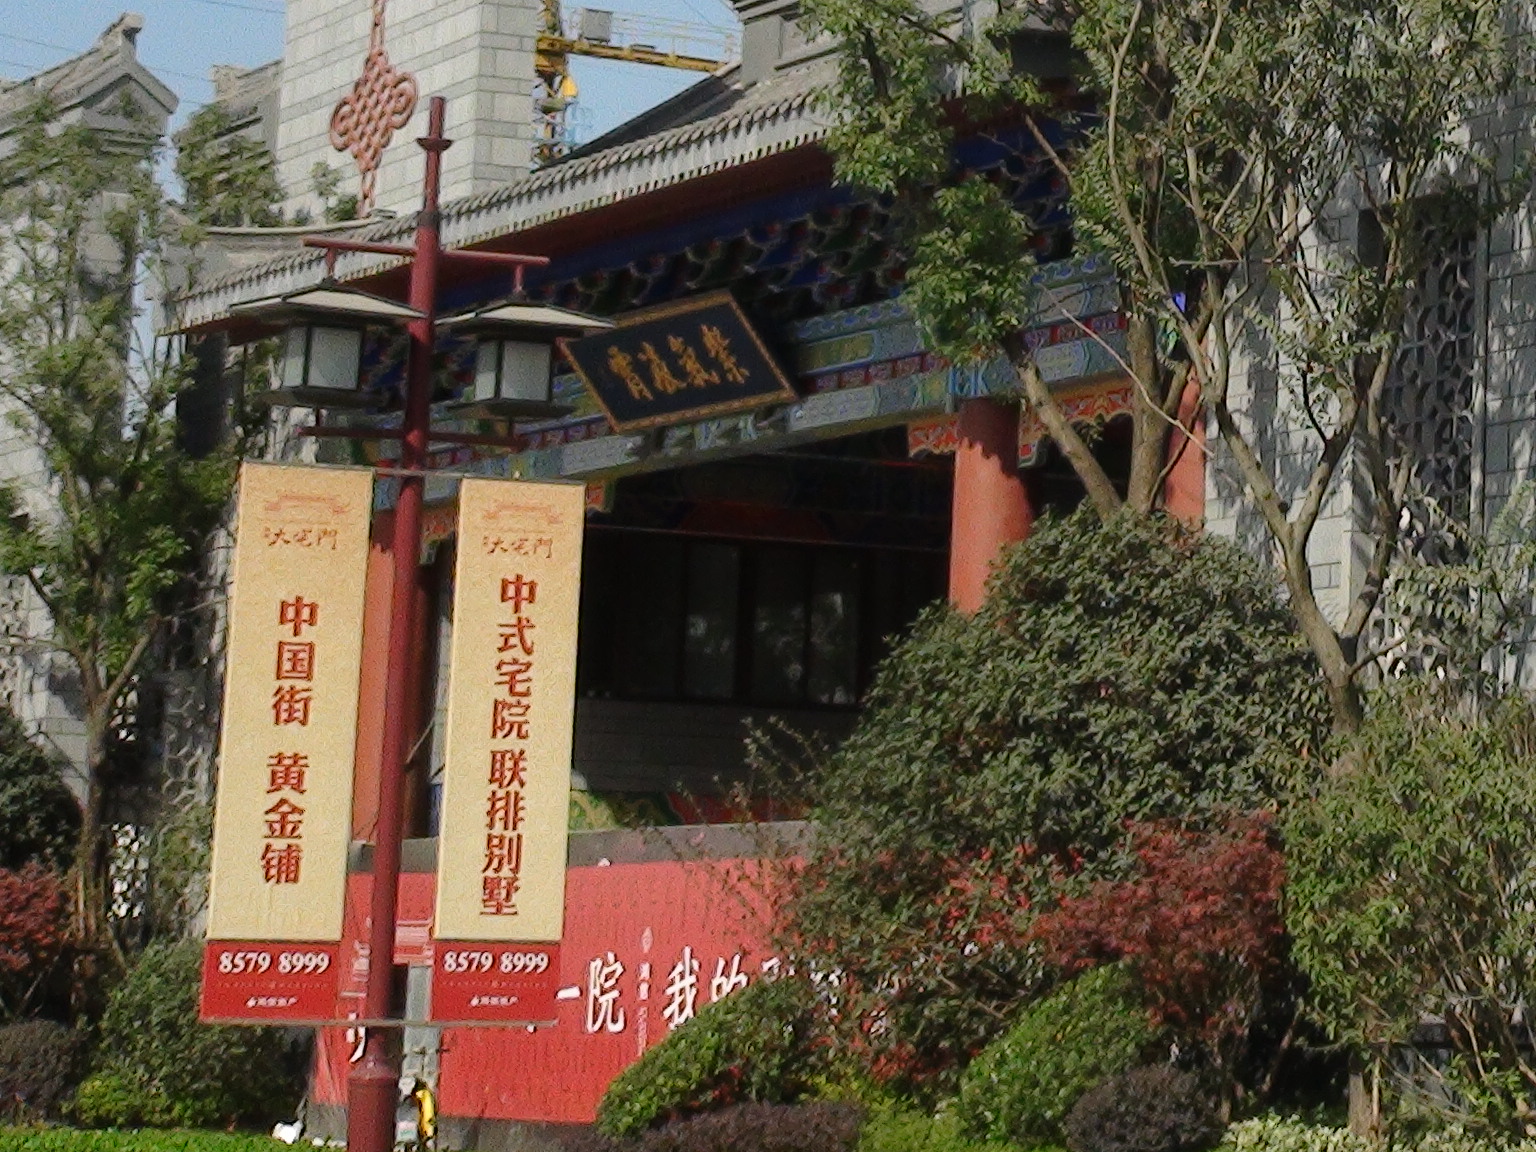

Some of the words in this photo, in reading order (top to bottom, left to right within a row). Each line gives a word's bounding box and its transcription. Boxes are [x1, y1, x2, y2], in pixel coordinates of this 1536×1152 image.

[219, 951, 271, 974] 8579
[278, 951, 330, 974] 8999
[443, 951, 494, 973] 8579
[500, 951, 549, 974] 8999
